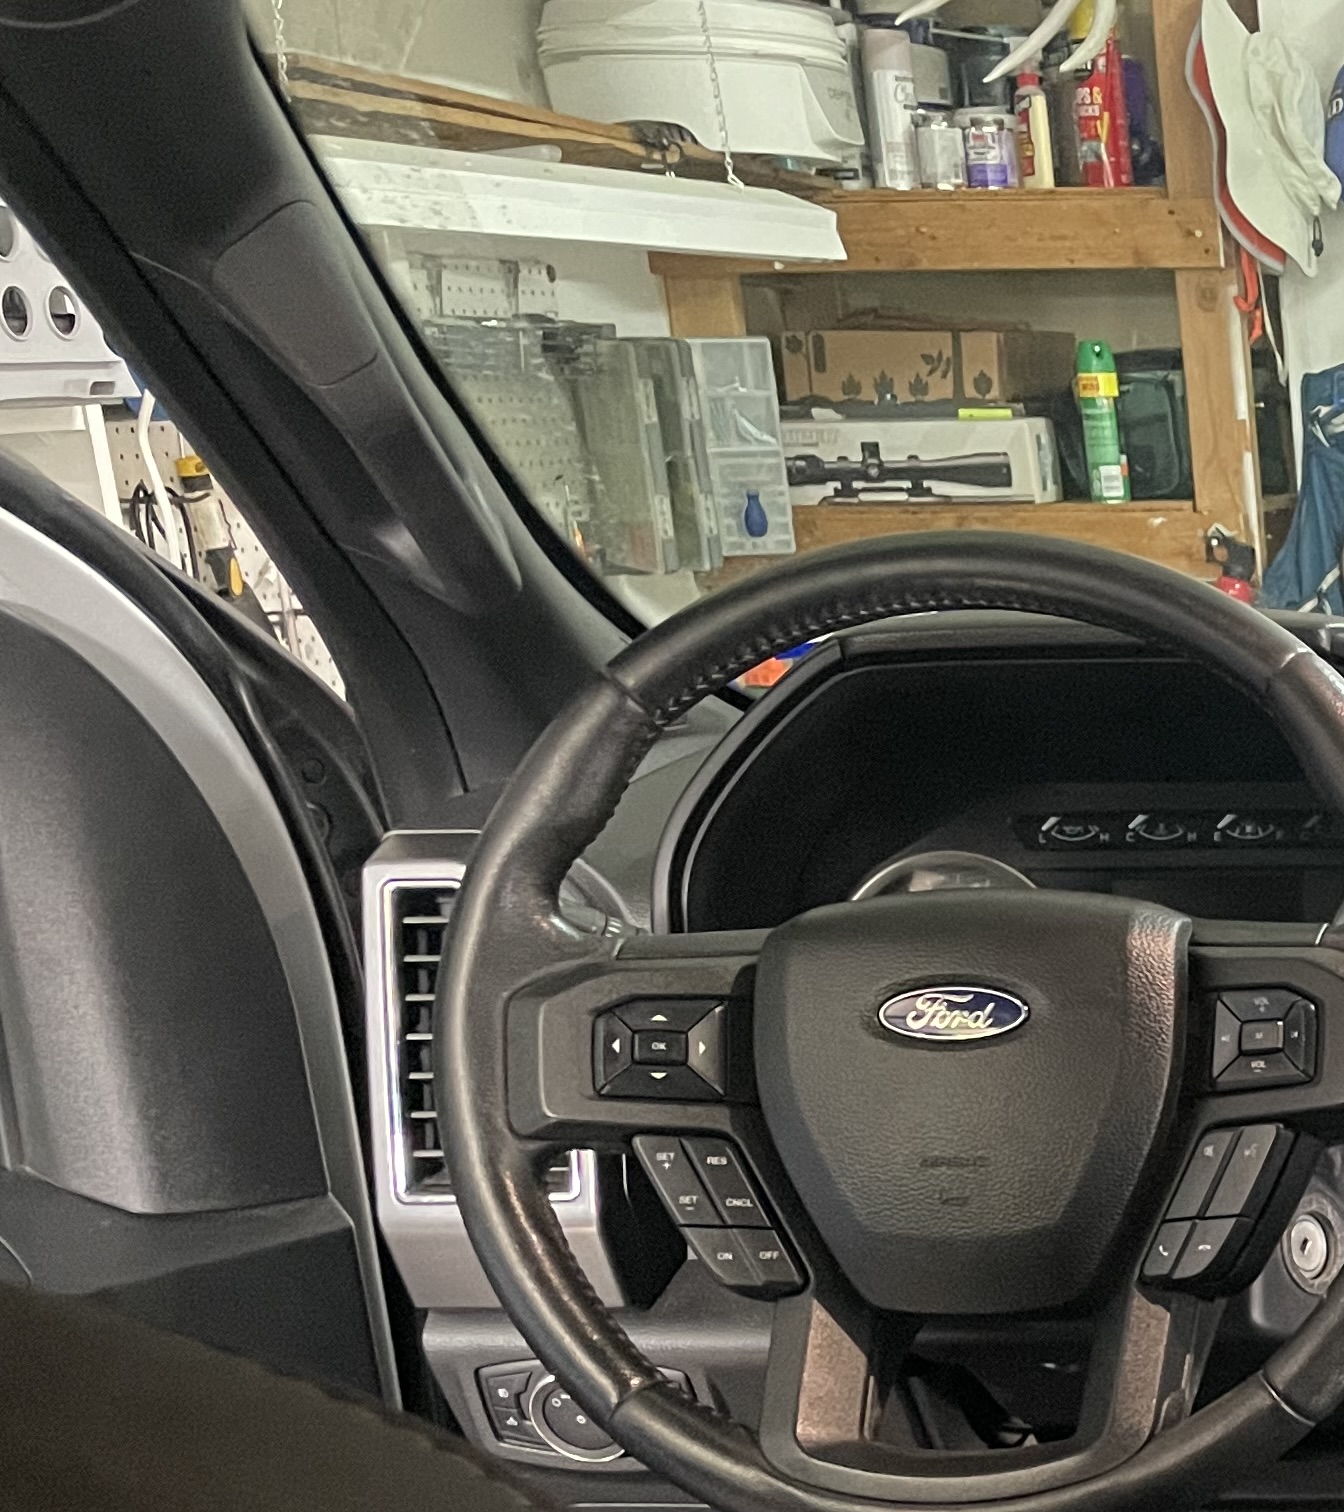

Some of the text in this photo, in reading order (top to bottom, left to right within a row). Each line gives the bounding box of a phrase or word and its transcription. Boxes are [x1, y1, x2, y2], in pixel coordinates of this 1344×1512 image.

[906, 993, 996, 1030] Ford
[651, 1042, 668, 1051] OK
[655, 1152, 675, 1161] SET
[706, 1156, 728, 1166] RES
[679, 1195, 698, 1205] SET
[726, 1198, 754, 1207] CNCL
[717, 1252, 732, 1260] ON
[758, 1252, 779, 1260] OFF
